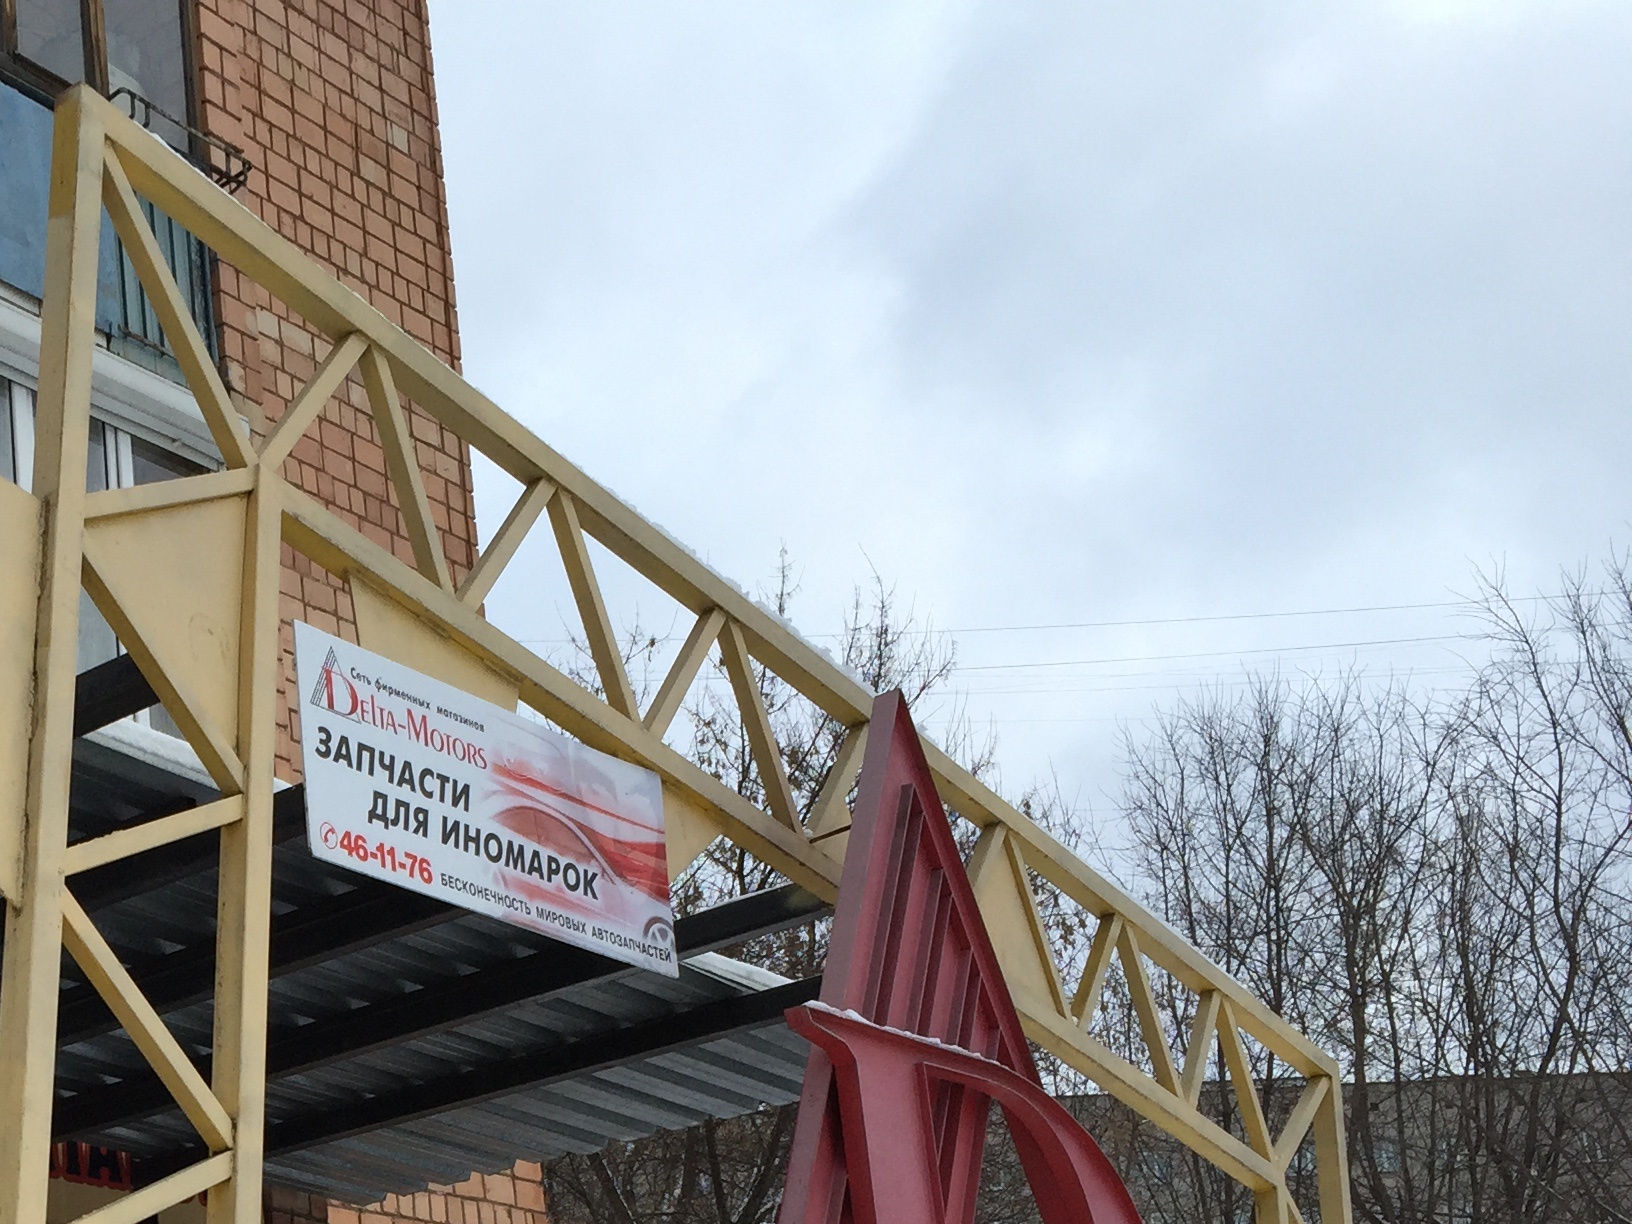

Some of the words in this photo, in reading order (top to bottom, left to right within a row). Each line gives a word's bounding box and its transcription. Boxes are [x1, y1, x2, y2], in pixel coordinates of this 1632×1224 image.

[350, 667, 372, 686] Сеть
[375, 677, 431, 710] фирменных
[436, 705, 486, 733] магазинов
[314, 725, 470, 813] ЗАПЧАСТИ
[339, 830, 433, 885] 46-11-76
[367, 790, 429, 838] ДЛЯ
[441, 816, 599, 900] ИНОМАРОК
[440, 872, 532, 915] БЕСКОНЕЧНОСТЬ
[535, 905, 587, 935] МИРОВЫХ
[591, 926, 672, 963] АВТОЗАПЧАСТЕЙ
